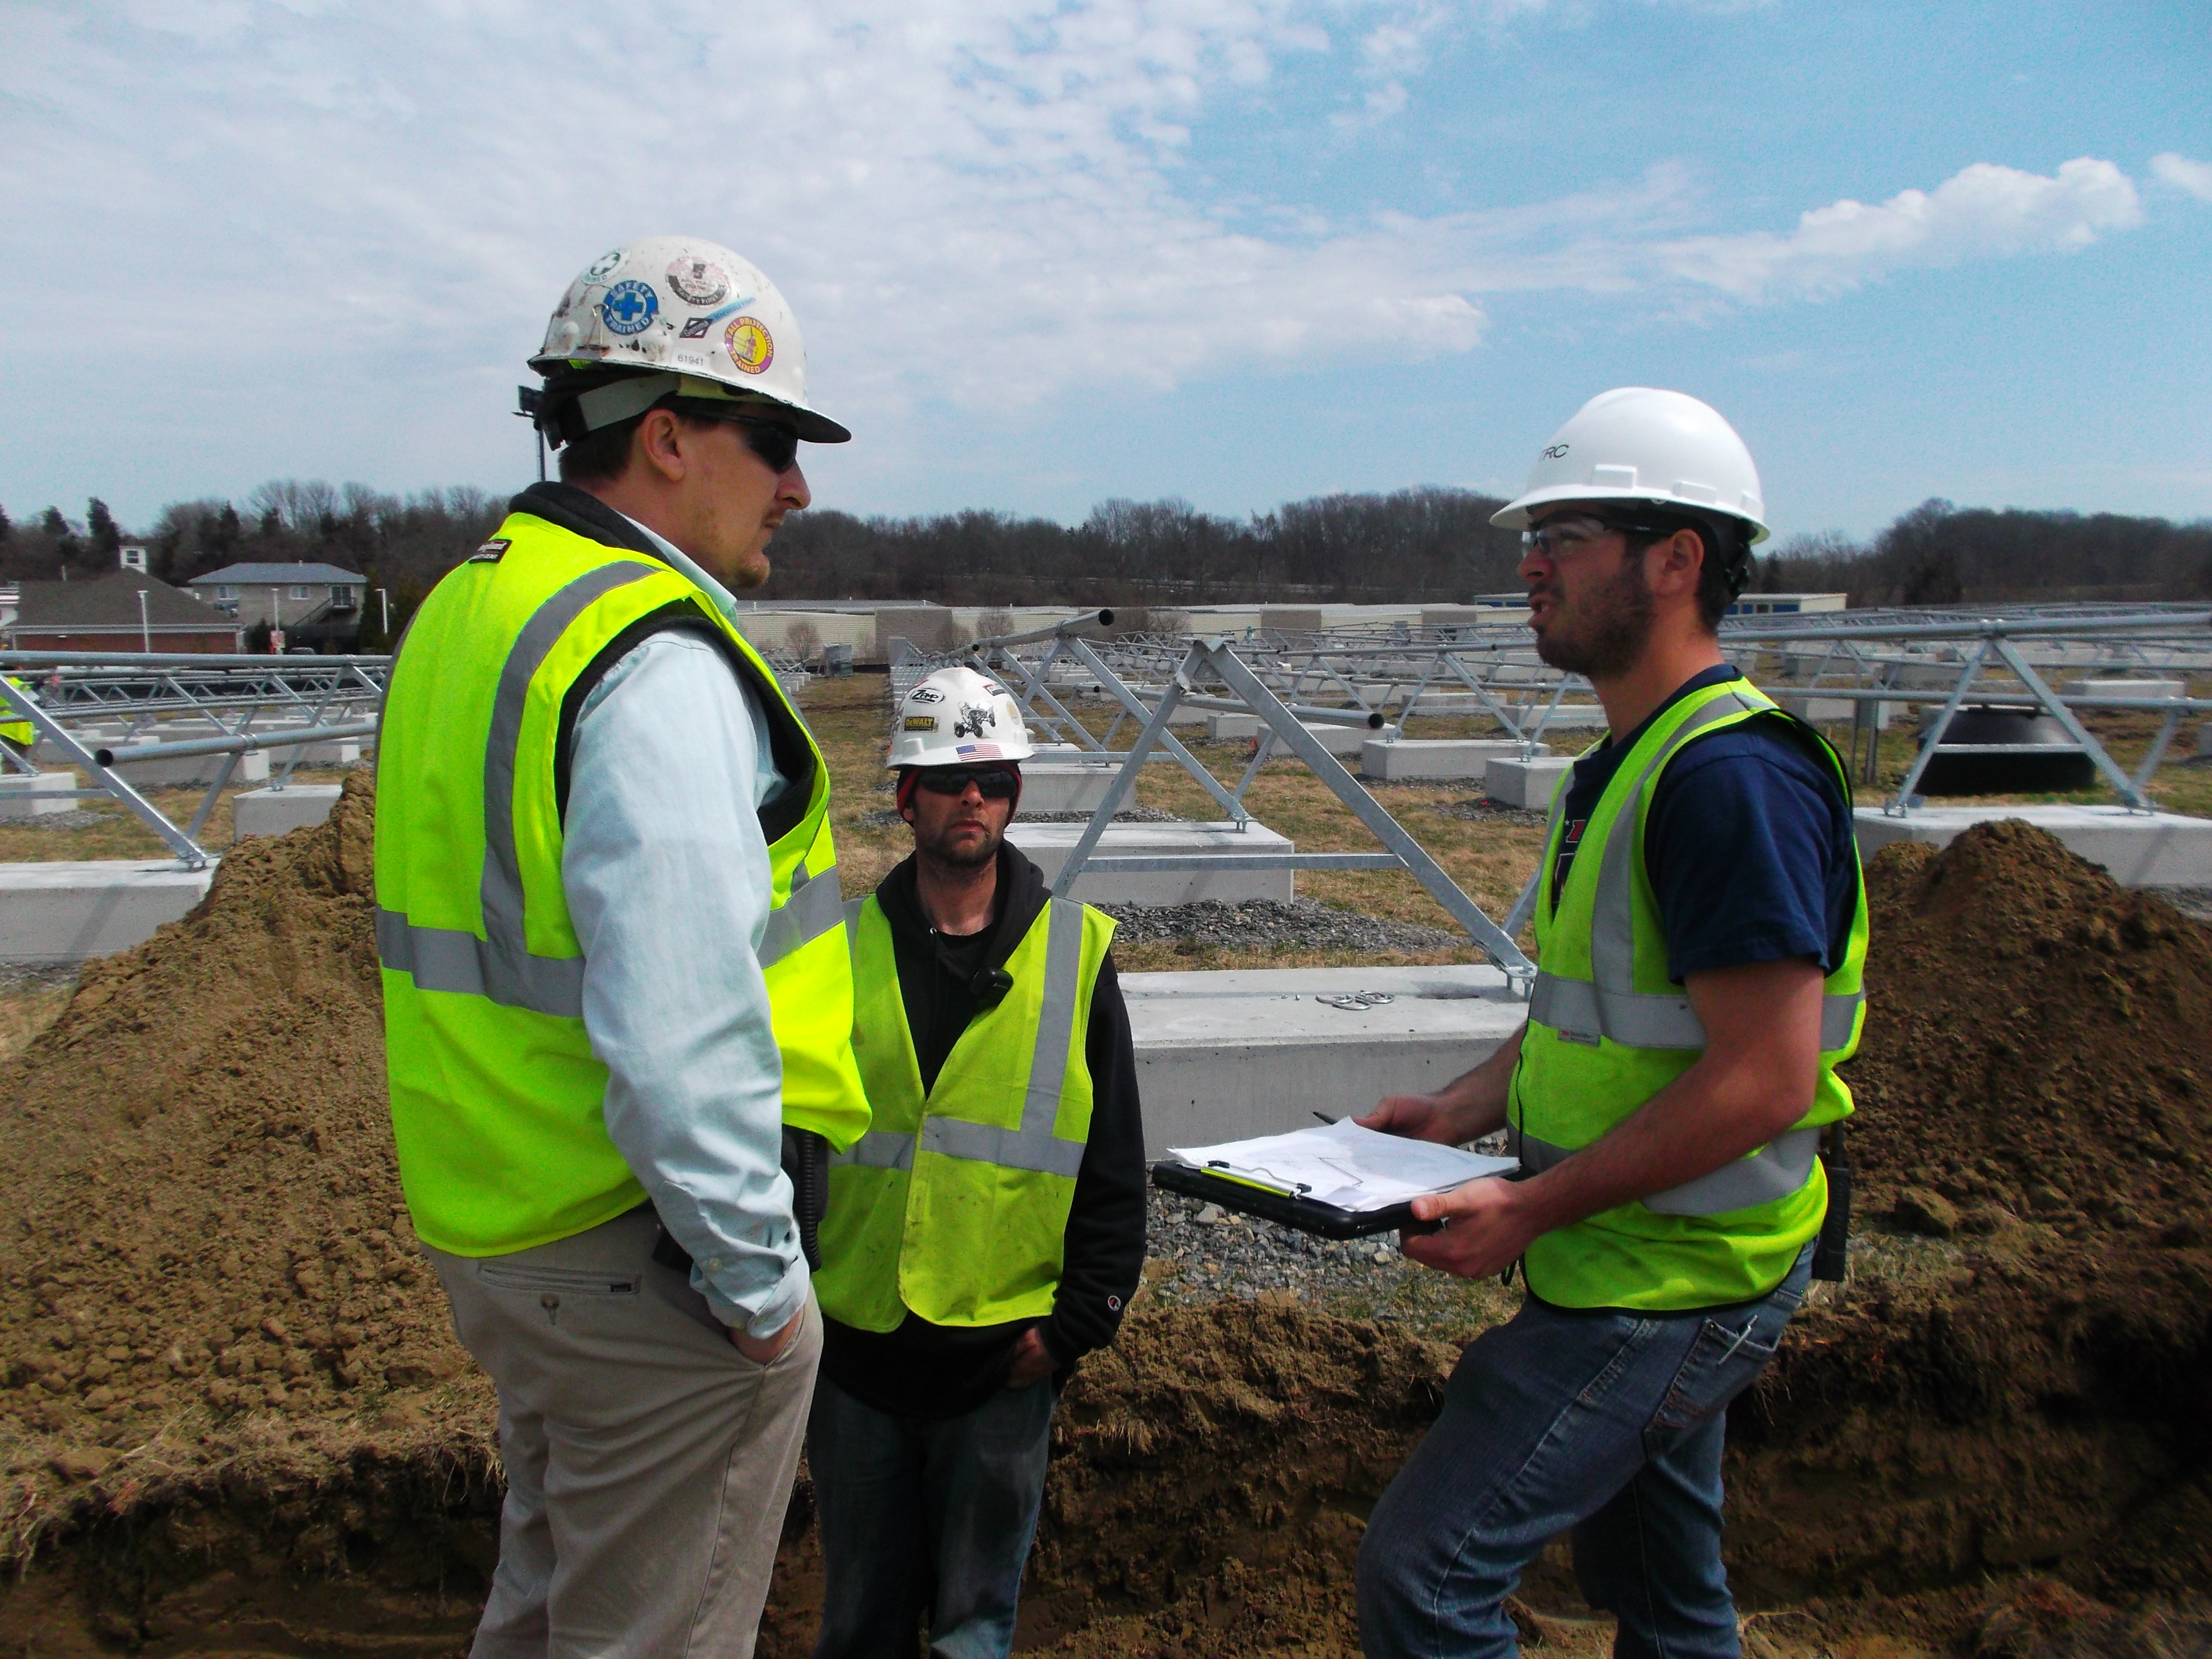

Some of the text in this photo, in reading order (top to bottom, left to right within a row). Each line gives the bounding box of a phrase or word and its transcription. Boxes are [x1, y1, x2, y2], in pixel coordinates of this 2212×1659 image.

[610, 283, 654, 298] SAFETY
[606, 315, 650, 333] TRAINED
[725, 317, 773, 357] FALL PROTECTION
[677, 354, 704, 366] 61941
[730, 349, 760, 373] TRAINED
[1538, 444, 1569, 461] TRC
